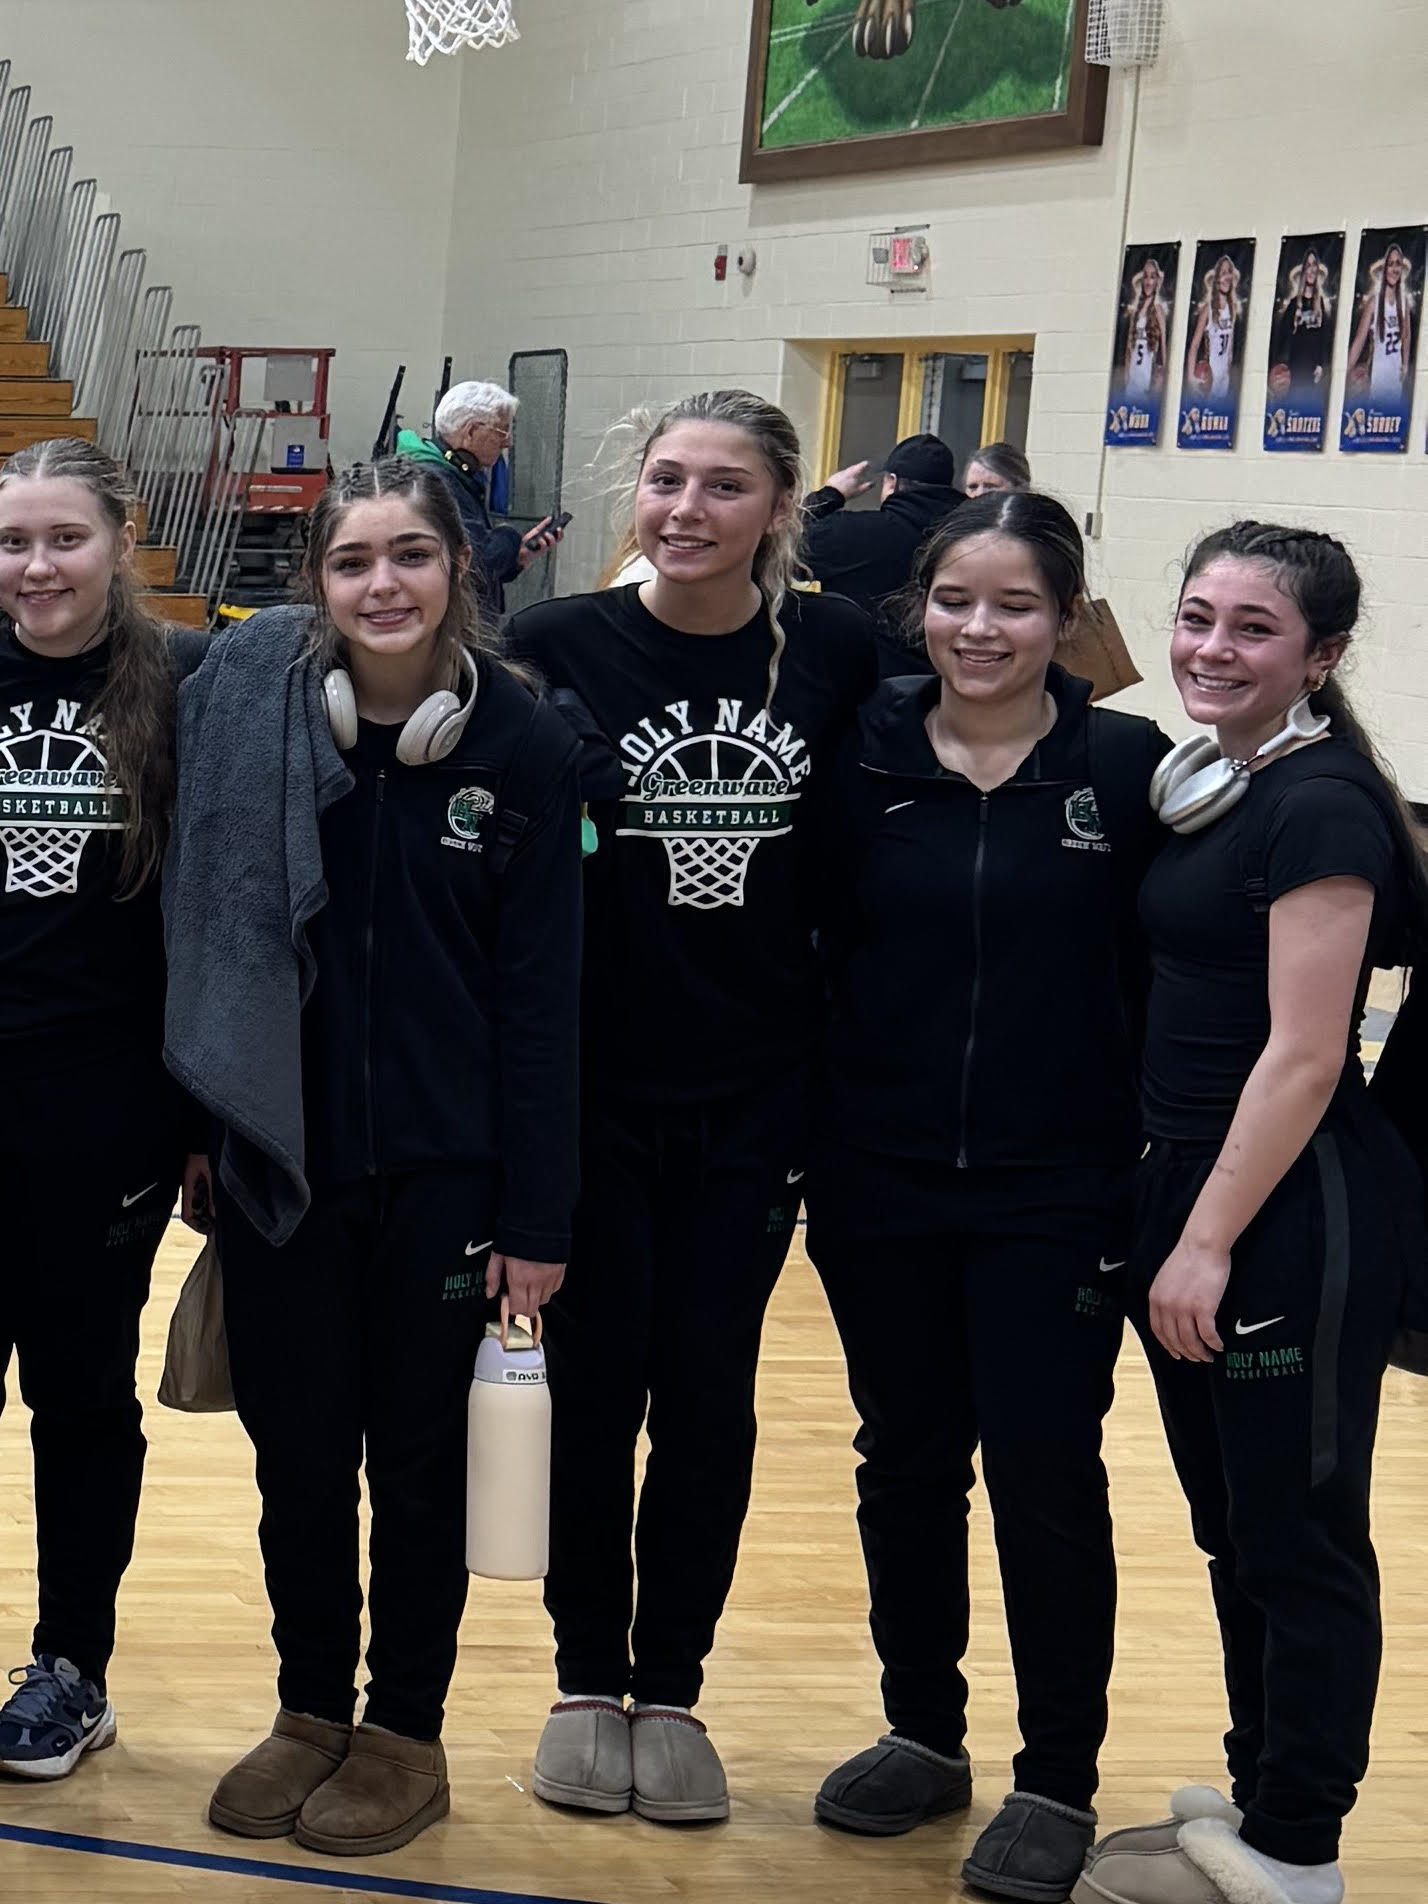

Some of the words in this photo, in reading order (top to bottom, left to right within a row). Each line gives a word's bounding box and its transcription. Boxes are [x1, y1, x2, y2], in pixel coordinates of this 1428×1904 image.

[714, 697, 811, 786] NAME
[641, 771, 790, 801] Greenwave
[644, 809, 780, 825] BASKETBALL
[1226, 1351, 1254, 1369] HOLY
[1259, 1347, 1304, 1368] NAME
